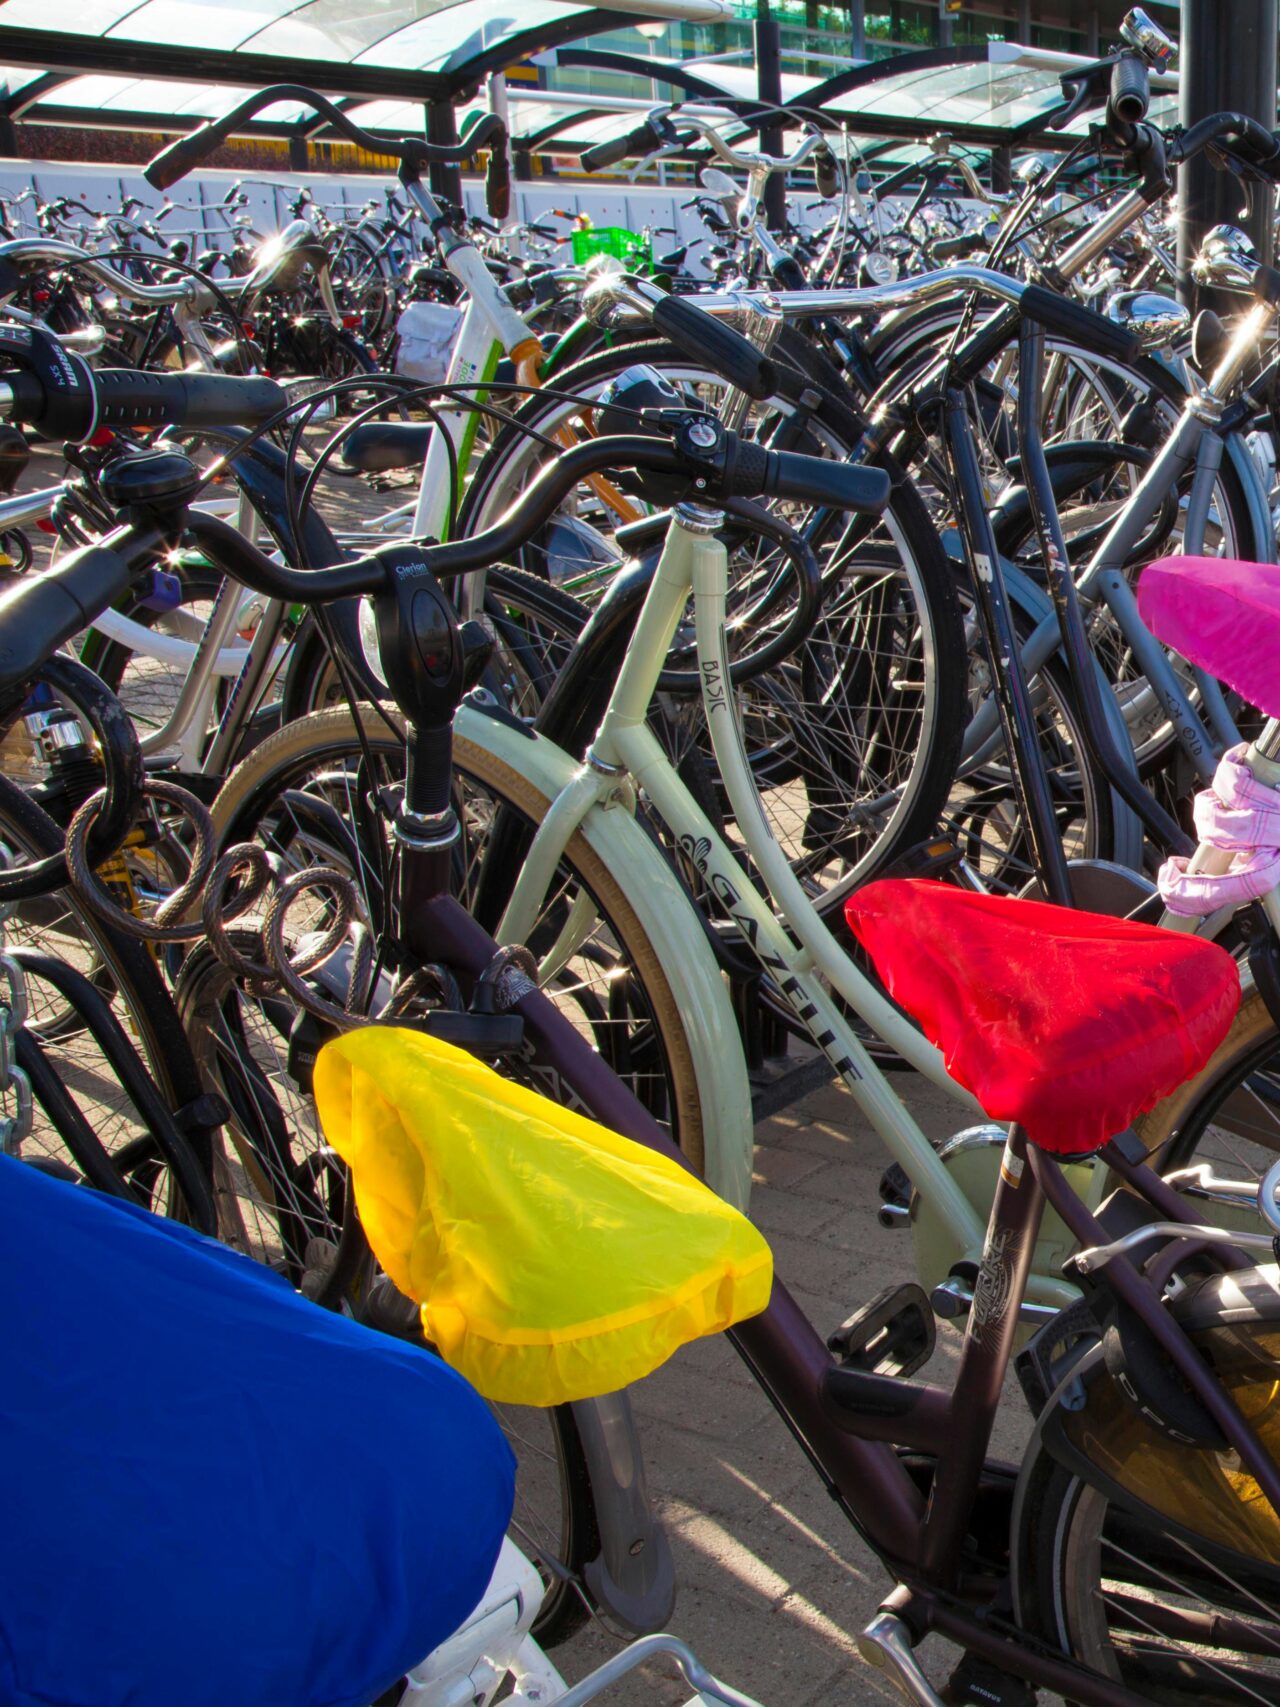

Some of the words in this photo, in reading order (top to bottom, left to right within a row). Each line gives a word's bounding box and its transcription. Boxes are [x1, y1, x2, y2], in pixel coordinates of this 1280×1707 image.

[51, 343, 79, 387] SRAM
[701, 660, 727, 714] BASIC
[711, 872, 863, 1090] GAZELLE
